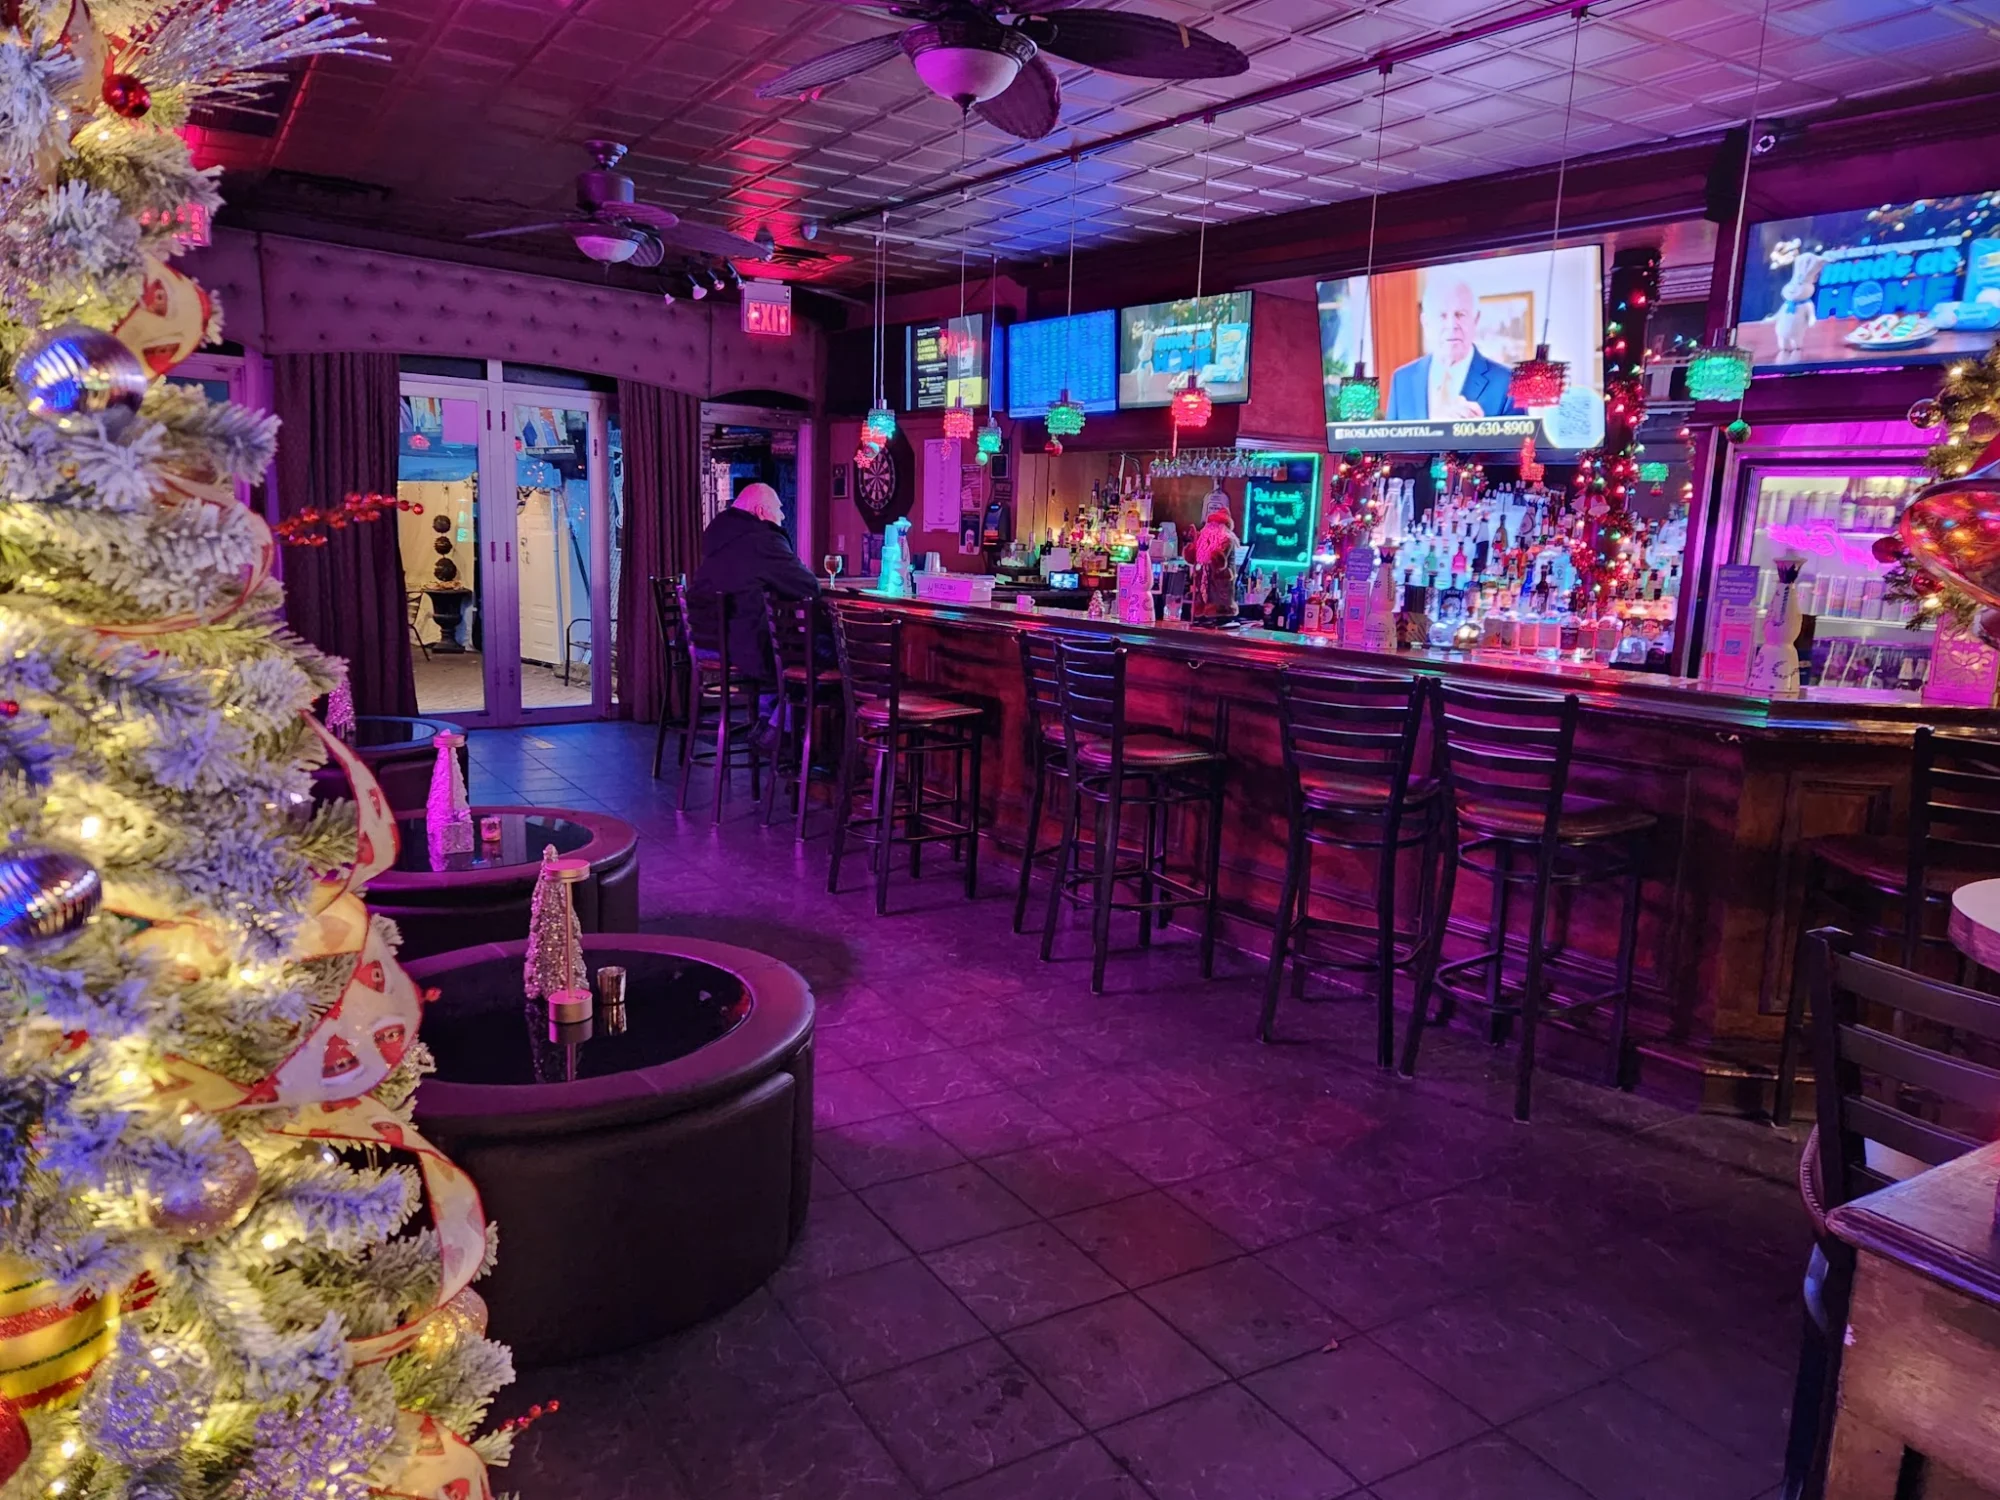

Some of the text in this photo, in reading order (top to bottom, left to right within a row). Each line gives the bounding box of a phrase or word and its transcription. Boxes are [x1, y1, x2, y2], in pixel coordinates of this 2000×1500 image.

[1819, 251, 1914, 286] made
[1915, 247, 1962, 276] at
[748, 302, 788, 333] EXIT
[1342, 427, 1389, 439] ROSLAND
[1452, 420, 1534, 436] 800-630-8900
